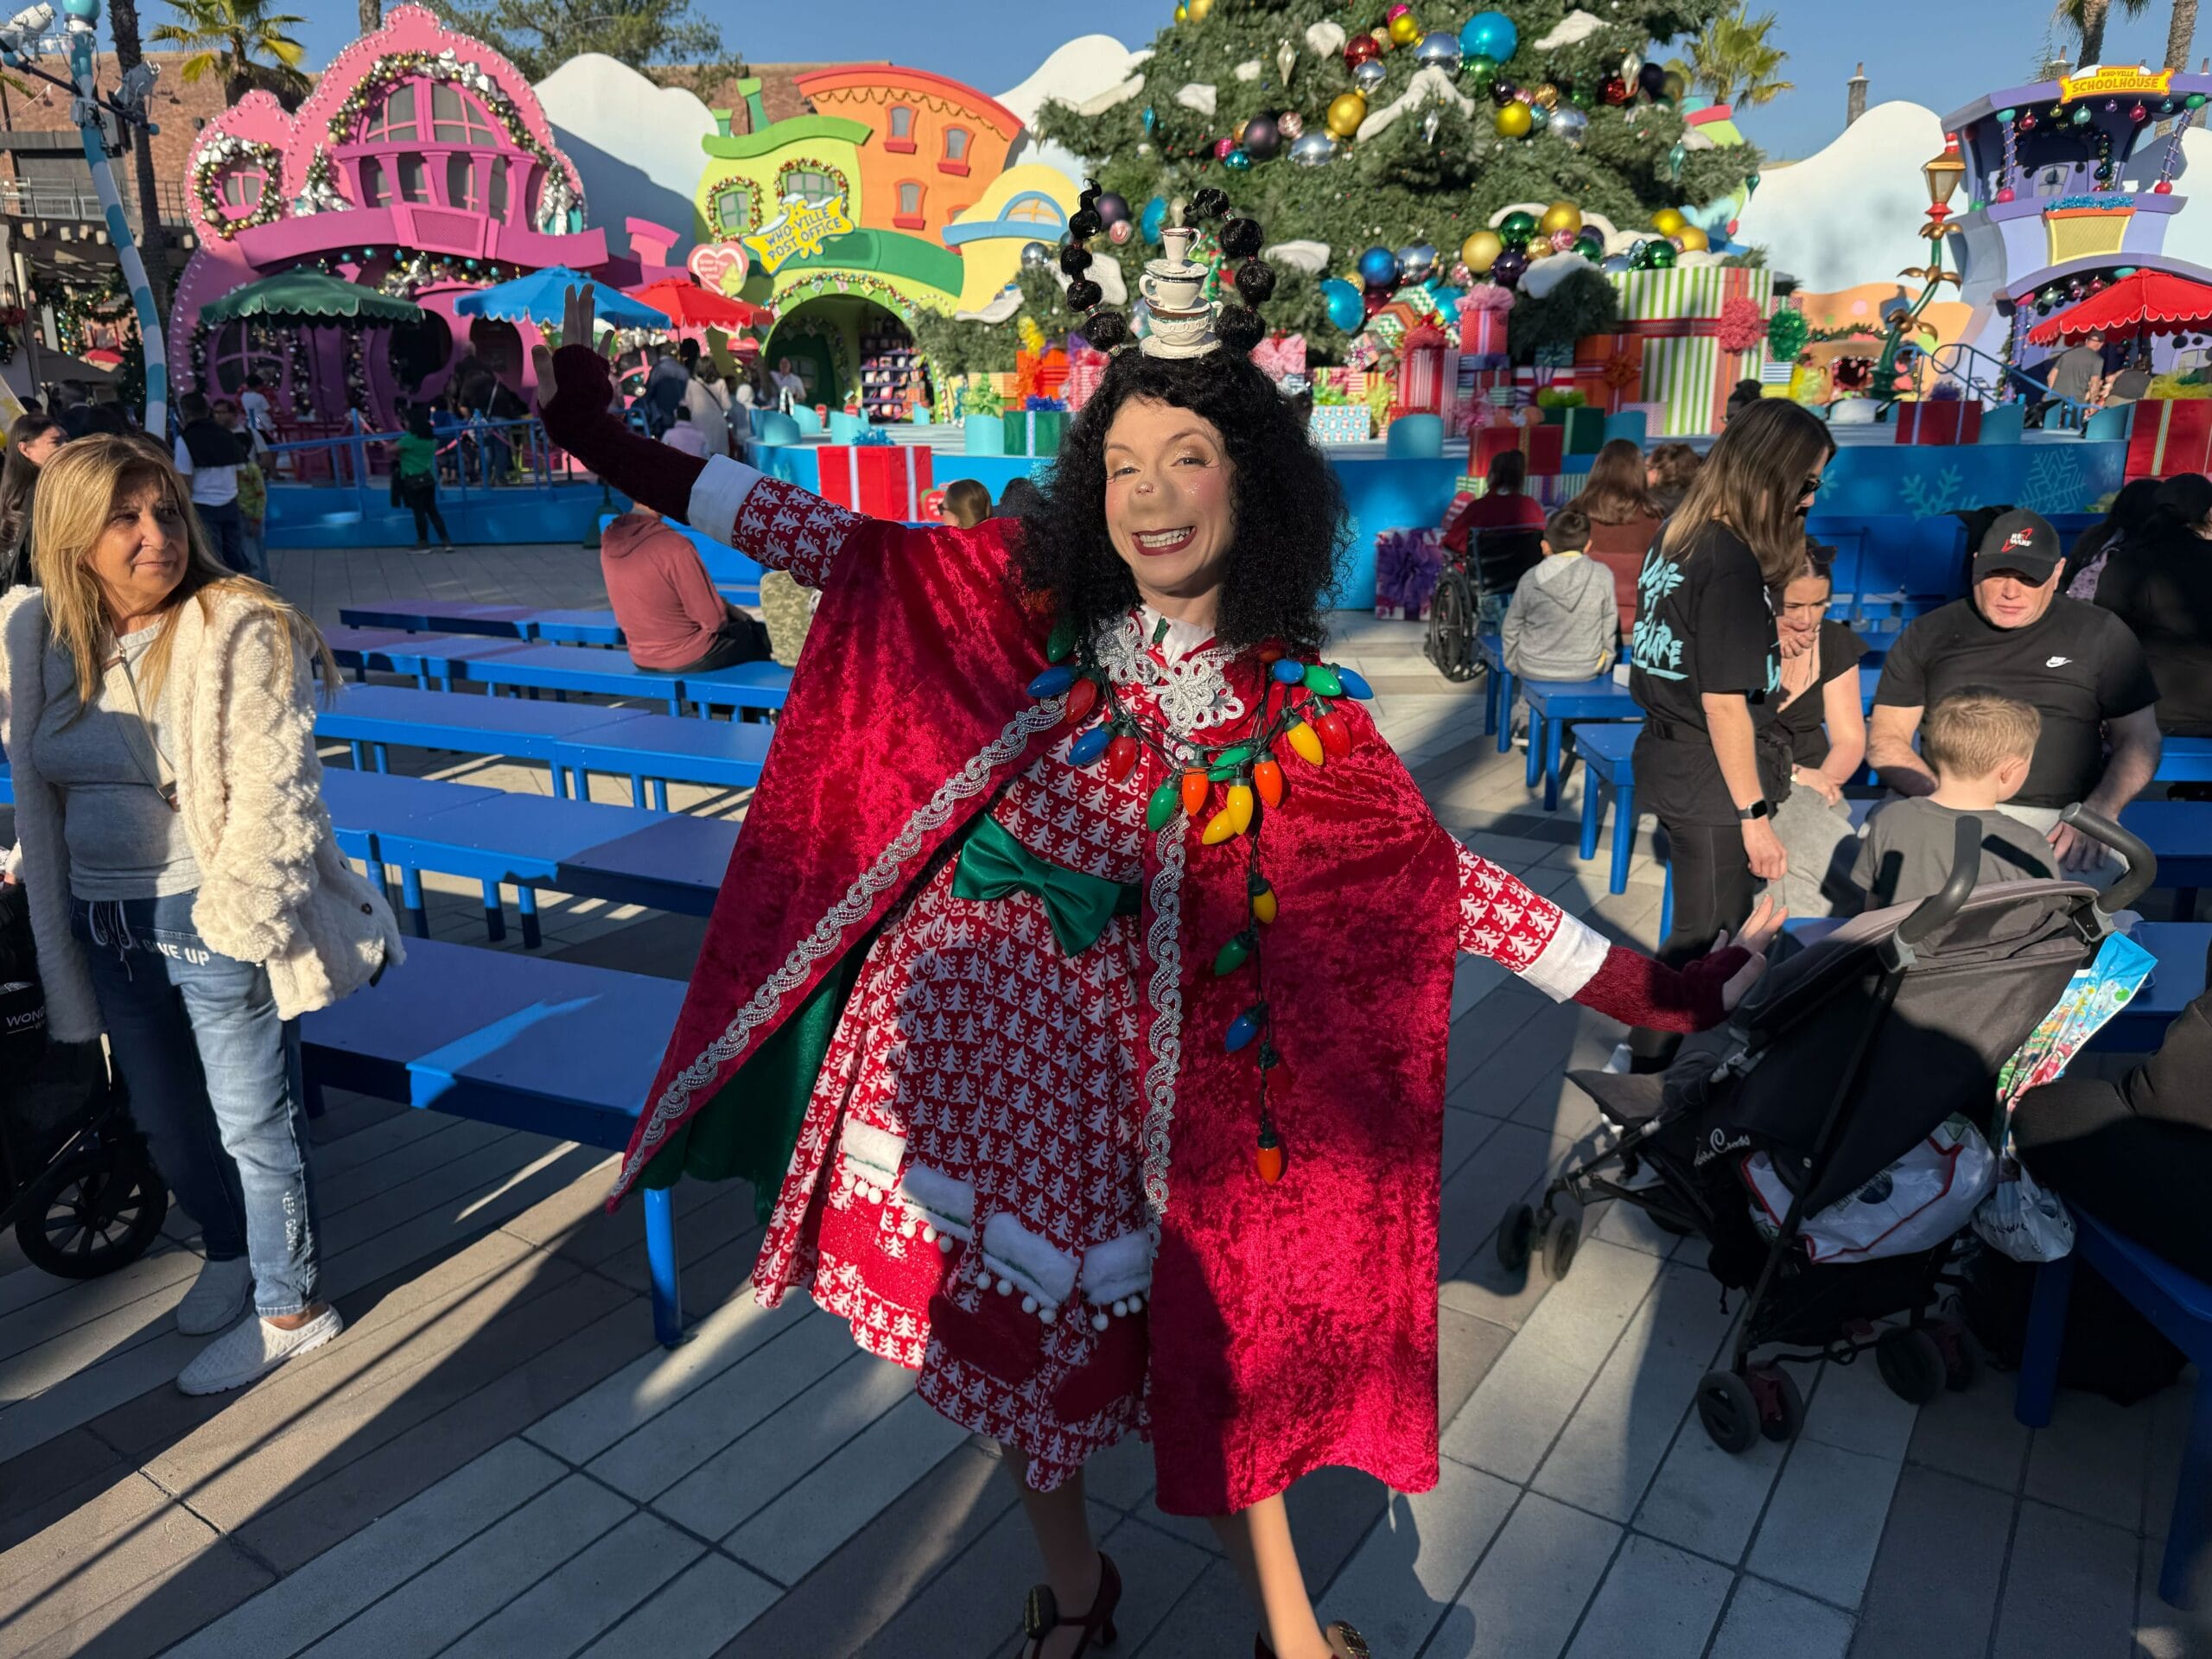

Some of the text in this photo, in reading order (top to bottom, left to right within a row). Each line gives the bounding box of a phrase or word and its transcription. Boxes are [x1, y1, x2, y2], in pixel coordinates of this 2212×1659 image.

[2072, 77, 2160, 92] SCHOOLHOUSE
[765, 207, 830, 246] WHO-VILLE
[767, 217, 842, 261] POST OFFICE
[184, 947, 210, 967] UP
